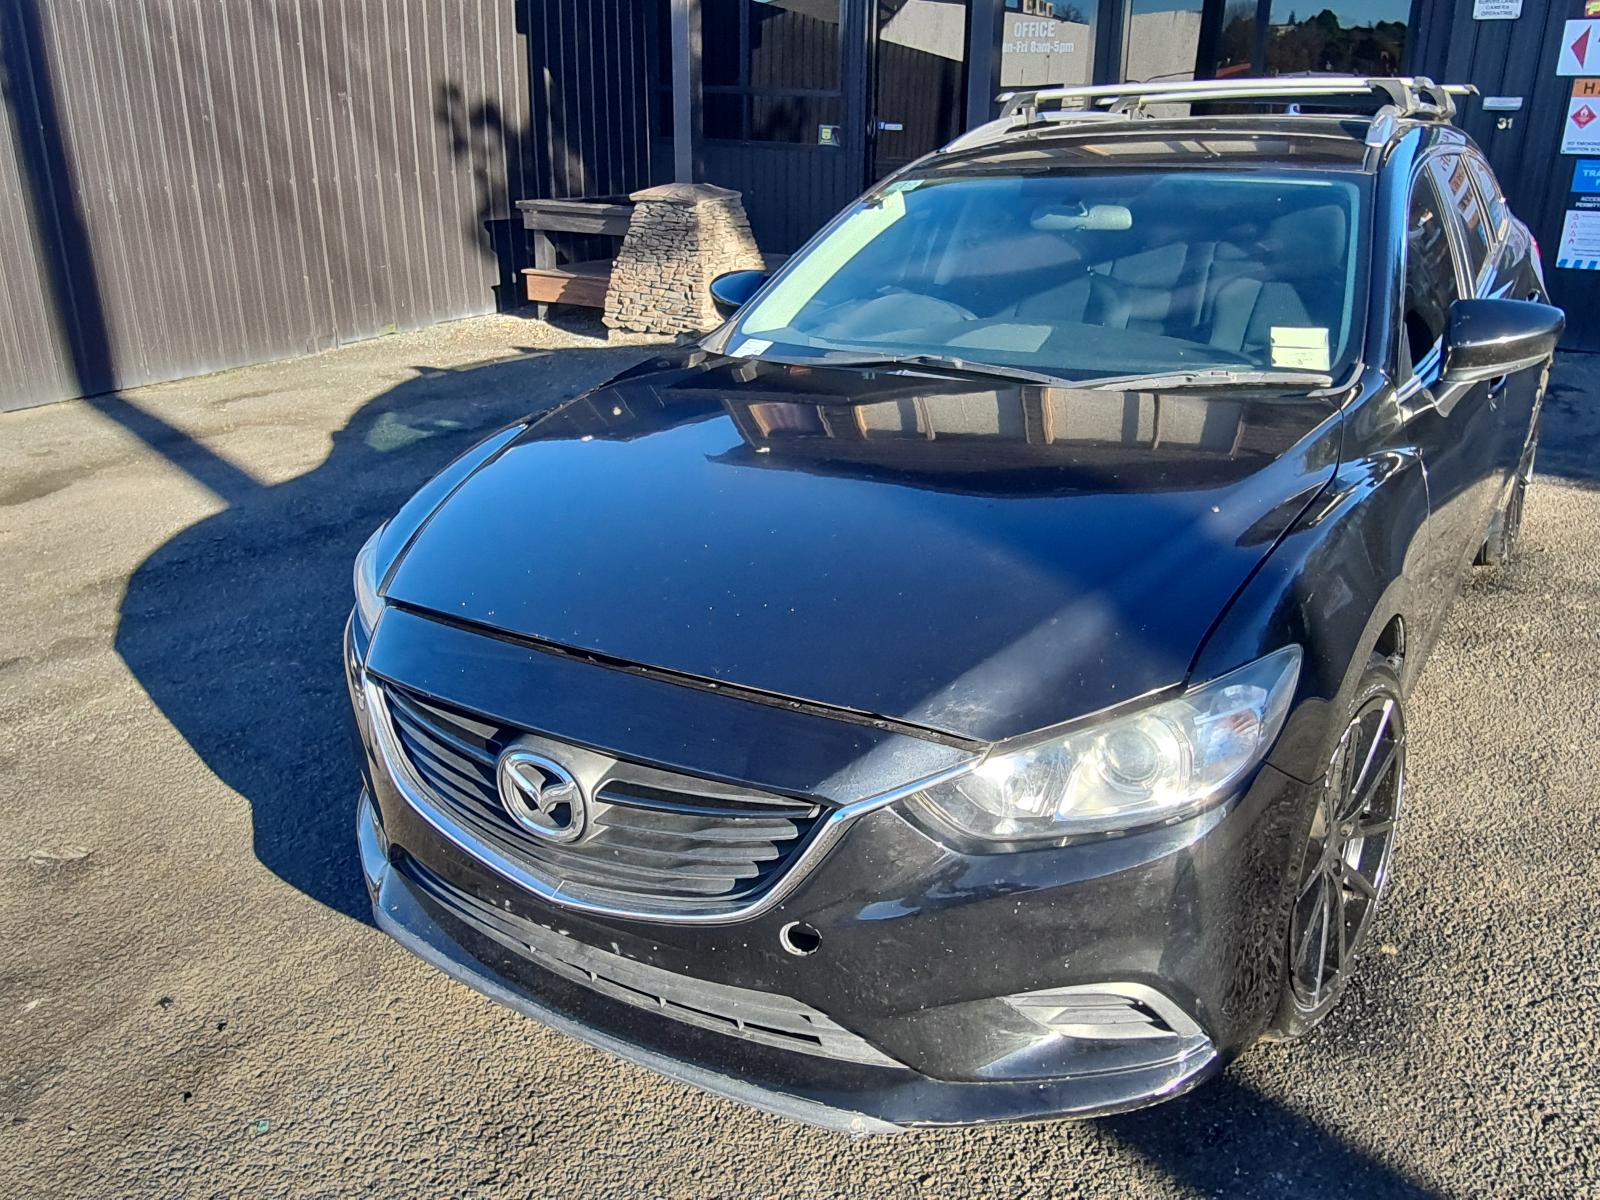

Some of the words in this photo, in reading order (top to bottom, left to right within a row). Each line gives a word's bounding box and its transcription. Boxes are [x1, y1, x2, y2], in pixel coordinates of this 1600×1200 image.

[1014, 21, 1056, 38] OFFICE
[1030, 40, 1075, 54] 8am-5pm
[1497, 117, 1513, 129] 31
